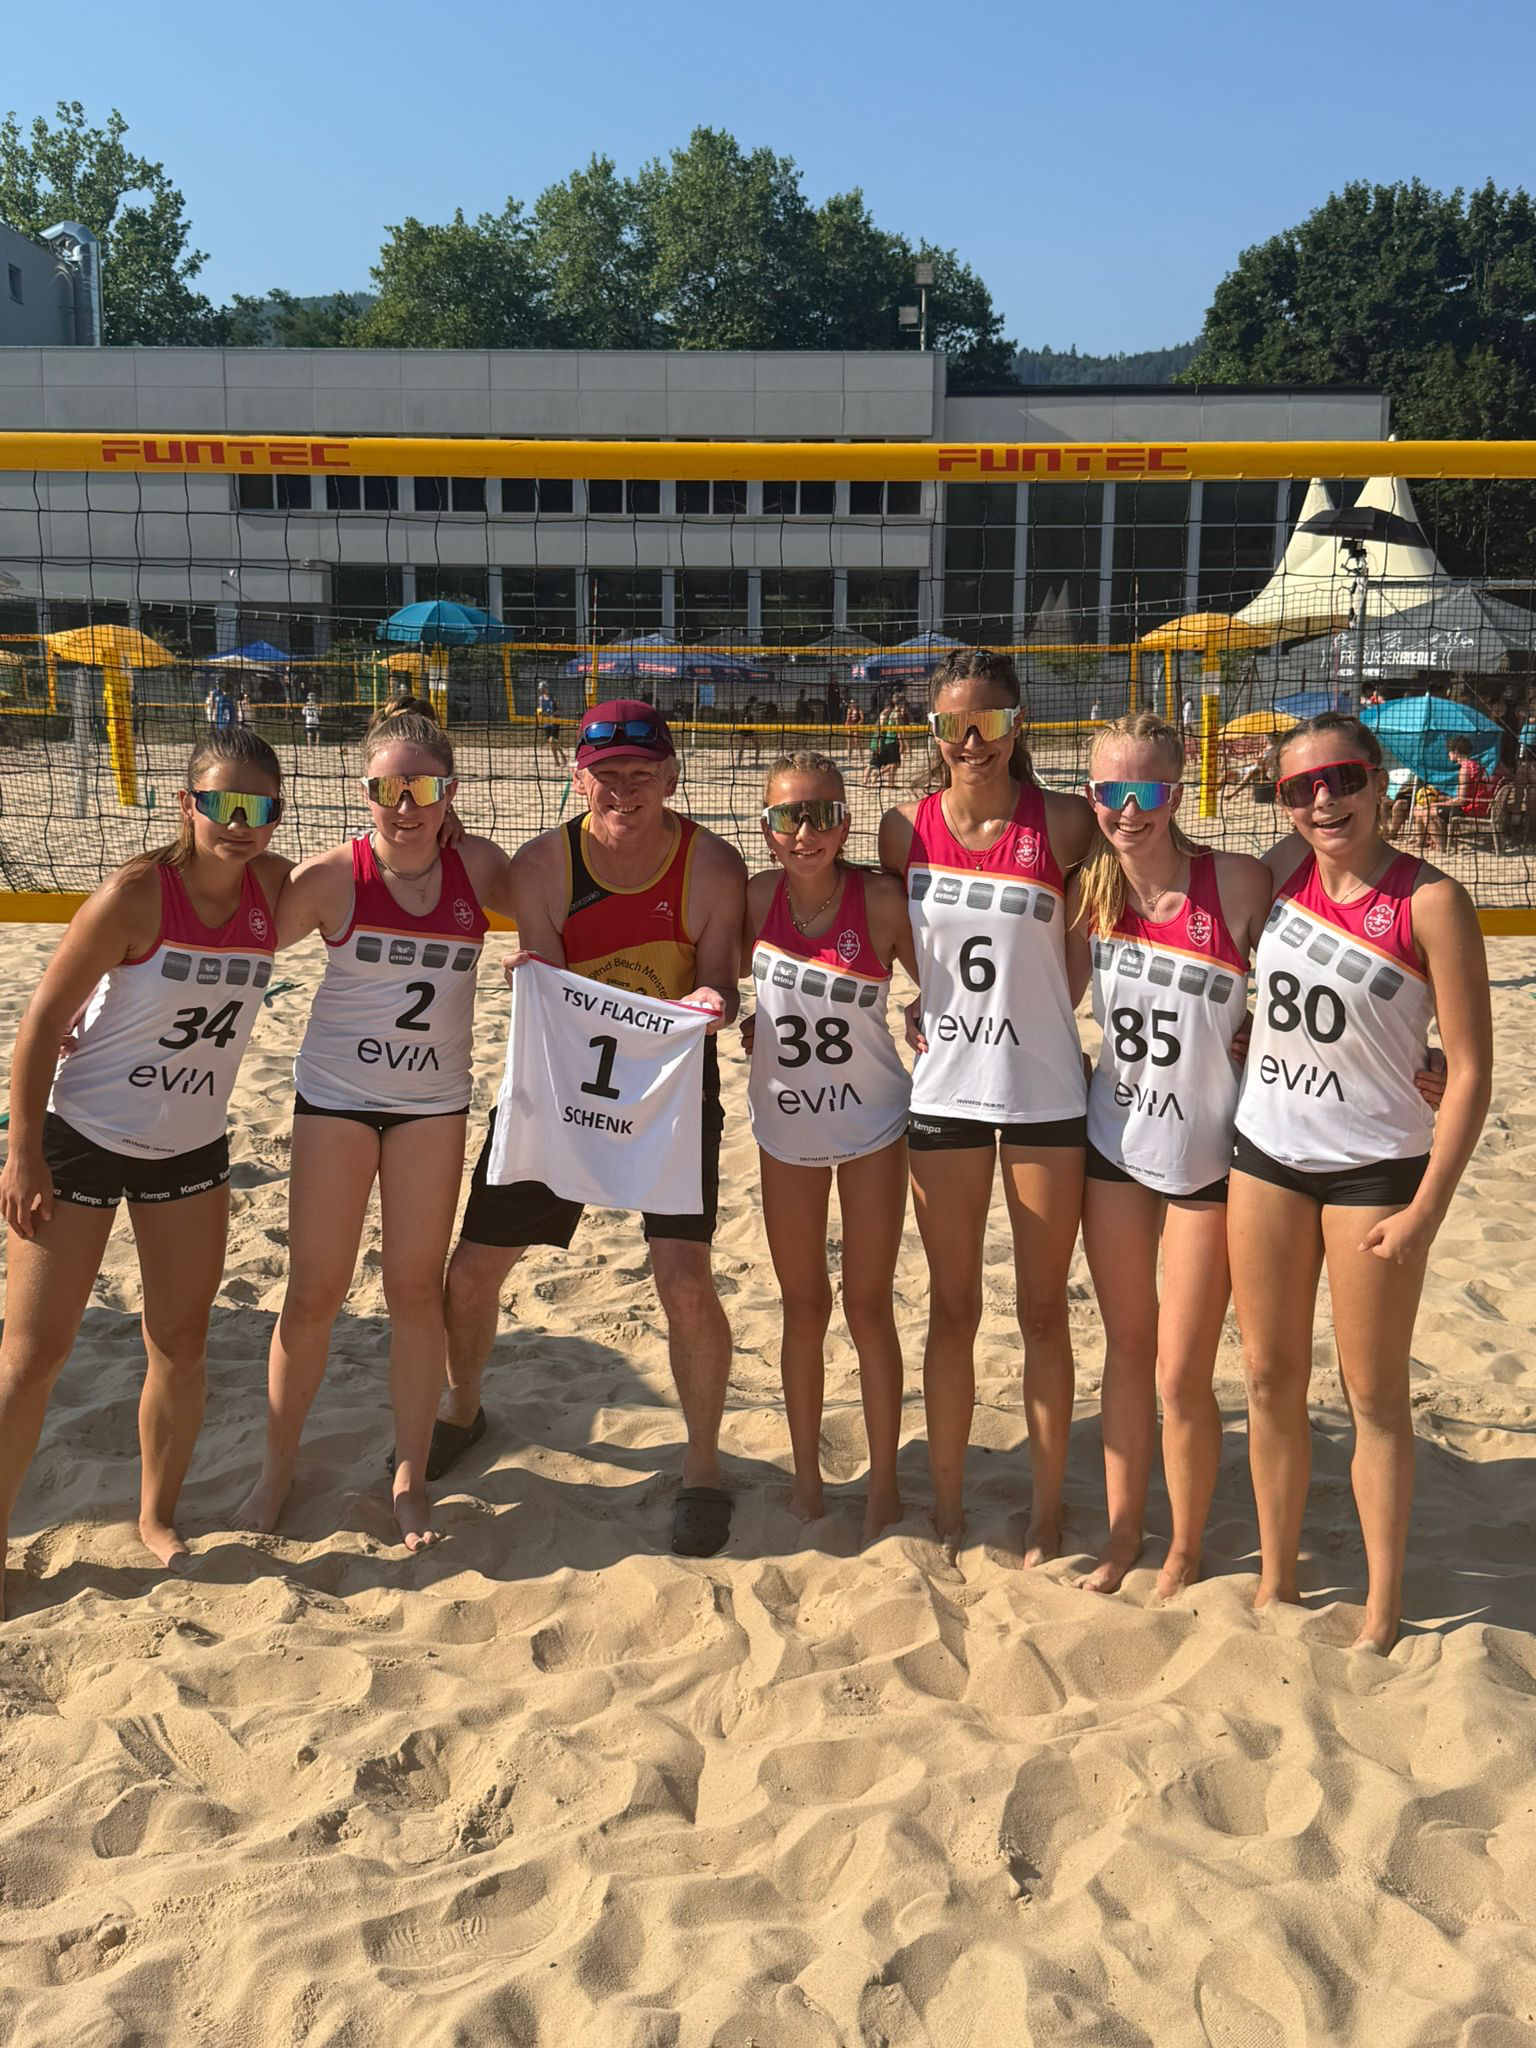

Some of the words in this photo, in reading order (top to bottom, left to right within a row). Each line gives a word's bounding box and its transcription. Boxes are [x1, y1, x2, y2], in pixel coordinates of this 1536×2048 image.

[101, 440, 350, 467] FUNTEC
[938, 448, 1187, 471] FUNTEC
[959, 935, 996, 993] 6
[158, 1000, 244, 1050] 34
[395, 981, 436, 1031] 2
[562, 987, 598, 1011] TSV
[600, 999, 675, 1035] FLACHT
[1267, 971, 1347, 1044] 80
[775, 1015, 853, 1068] 38
[1111, 1007, 1181, 1067] 85
[580, 1035, 620, 1100] 1
[563, 1106, 634, 1135] SCHENK
[914, 1119, 942, 1135] Kempa
[72, 1191, 103, 1206] Kempa
[140, 1191, 171, 1201] Kempa
[180, 1179, 214, 1195] Kempa
